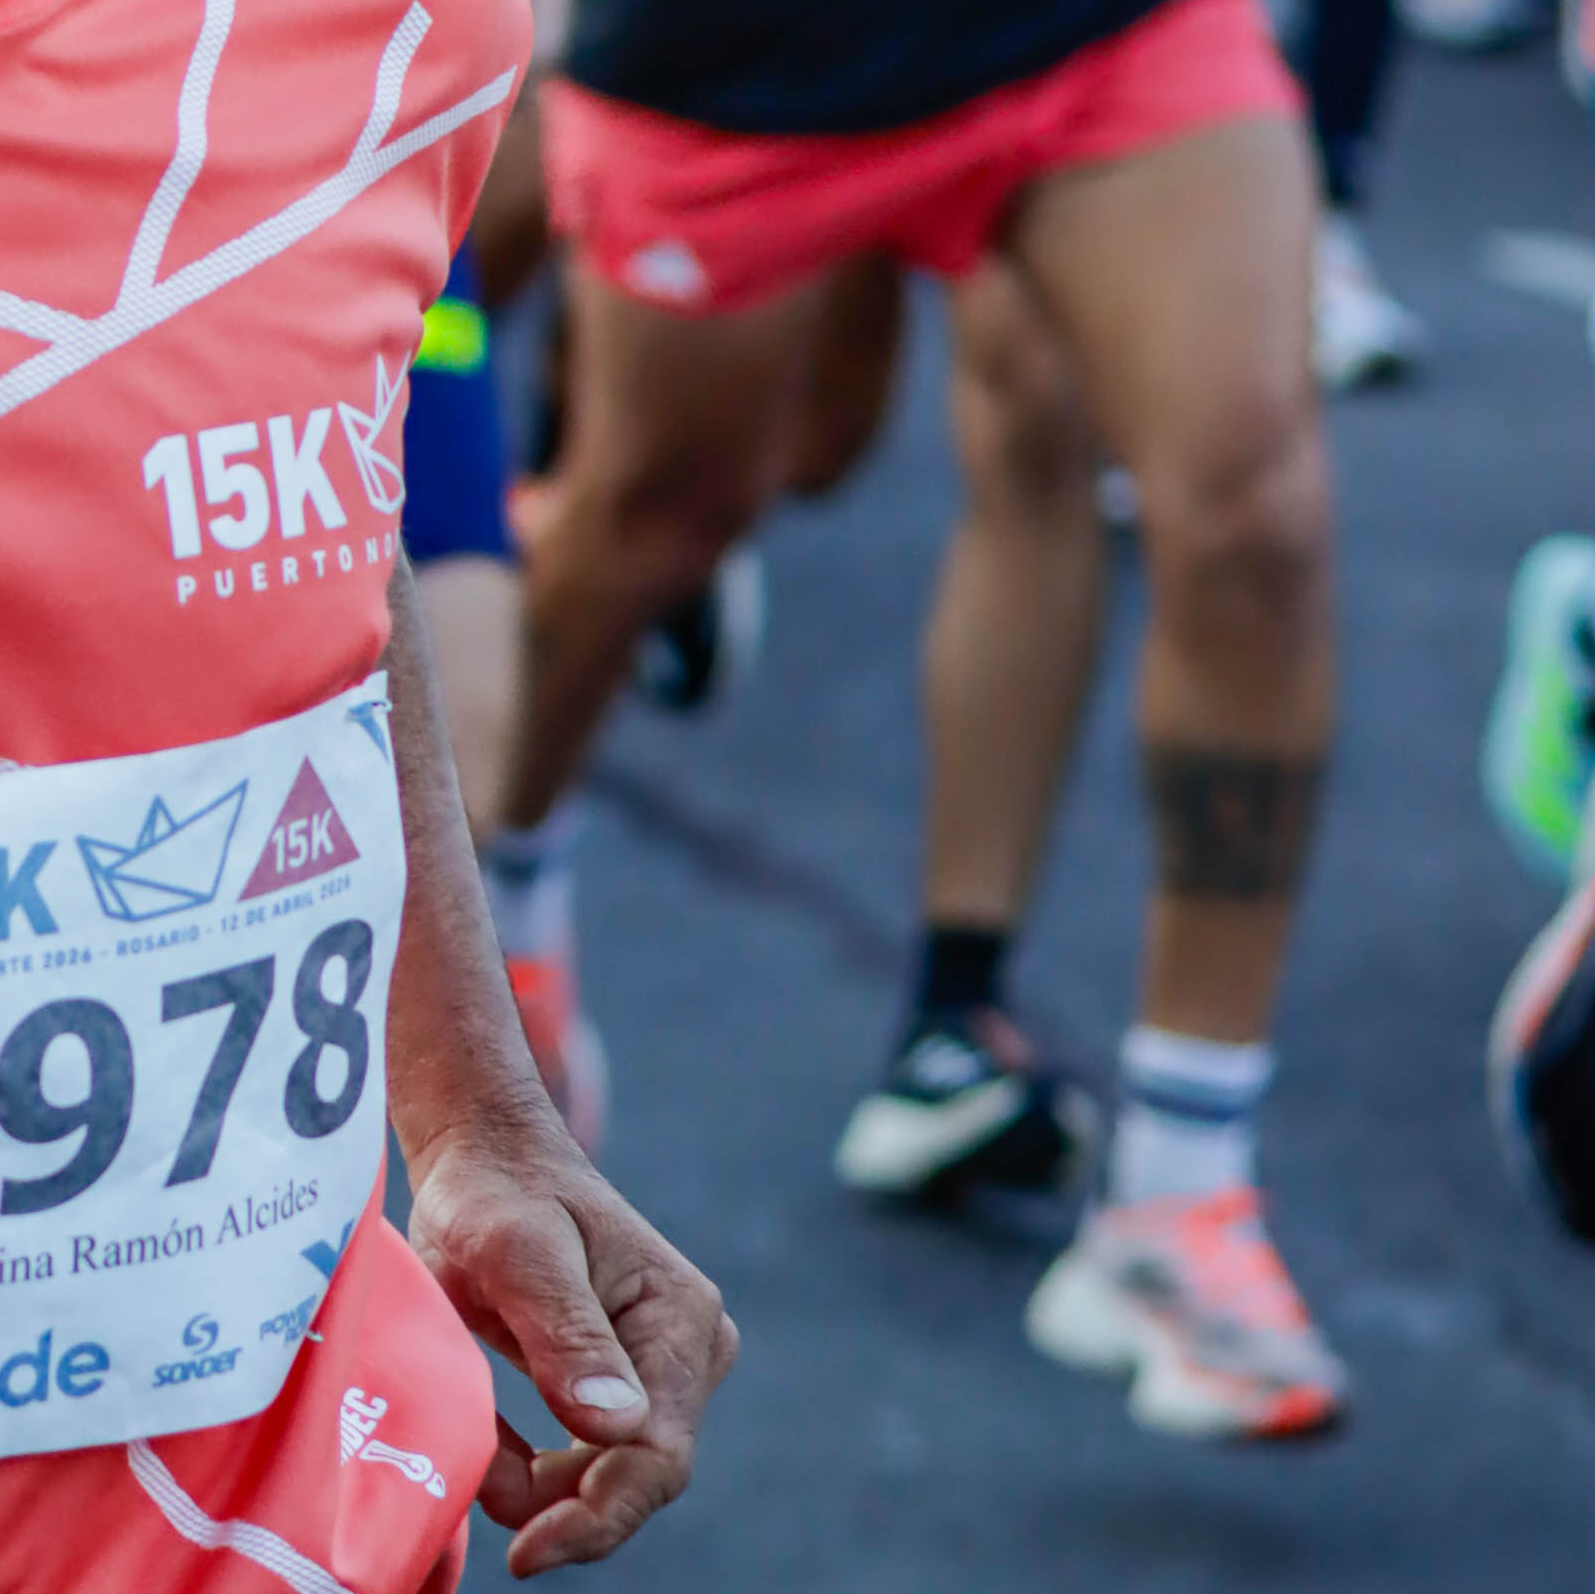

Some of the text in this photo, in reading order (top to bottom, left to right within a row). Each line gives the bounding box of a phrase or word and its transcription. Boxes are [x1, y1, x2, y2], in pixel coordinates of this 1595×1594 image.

[142, 407, 347, 559] 15K
[176, 544, 353, 606] PUERTO
[271, 807, 334, 874] 15K
[116, 925, 199, 955] ROSARIO
[221, 914, 238, 932] 12
[246, 907, 266, 926] DE
[273, 892, 314, 916] ABRIL
[70, 1219, 204, 1274] Ramón
[217, 1178, 319, 1245] Alcides
